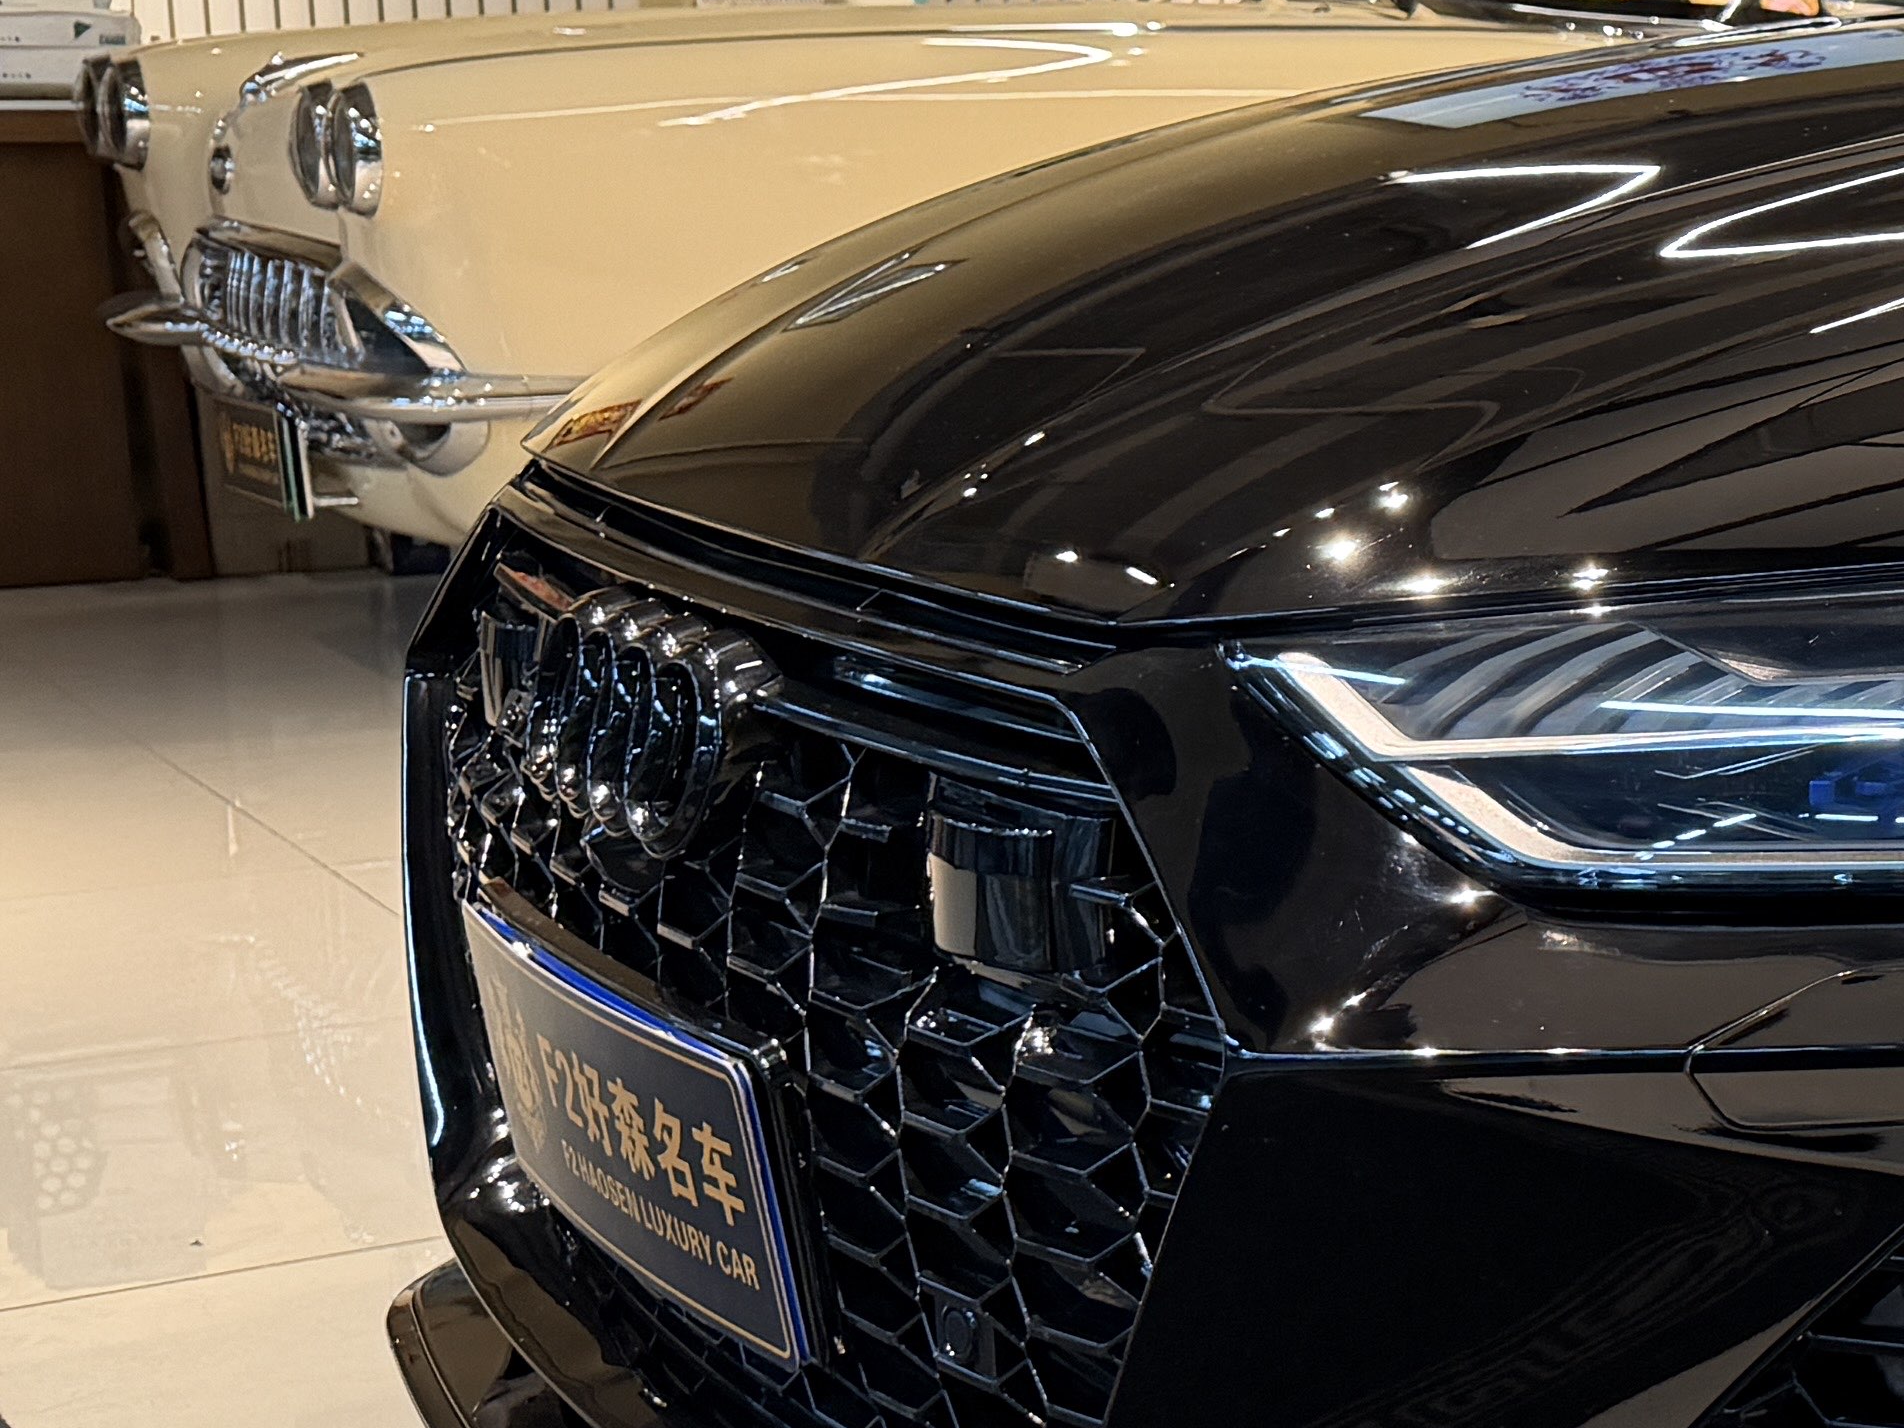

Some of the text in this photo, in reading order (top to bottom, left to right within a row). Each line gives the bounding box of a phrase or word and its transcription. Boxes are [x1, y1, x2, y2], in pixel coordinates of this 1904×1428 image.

[537, 1033, 746, 1227] F2好森名车
[561, 1138, 760, 1291] F2 HAOSEN LUXURY CAR
